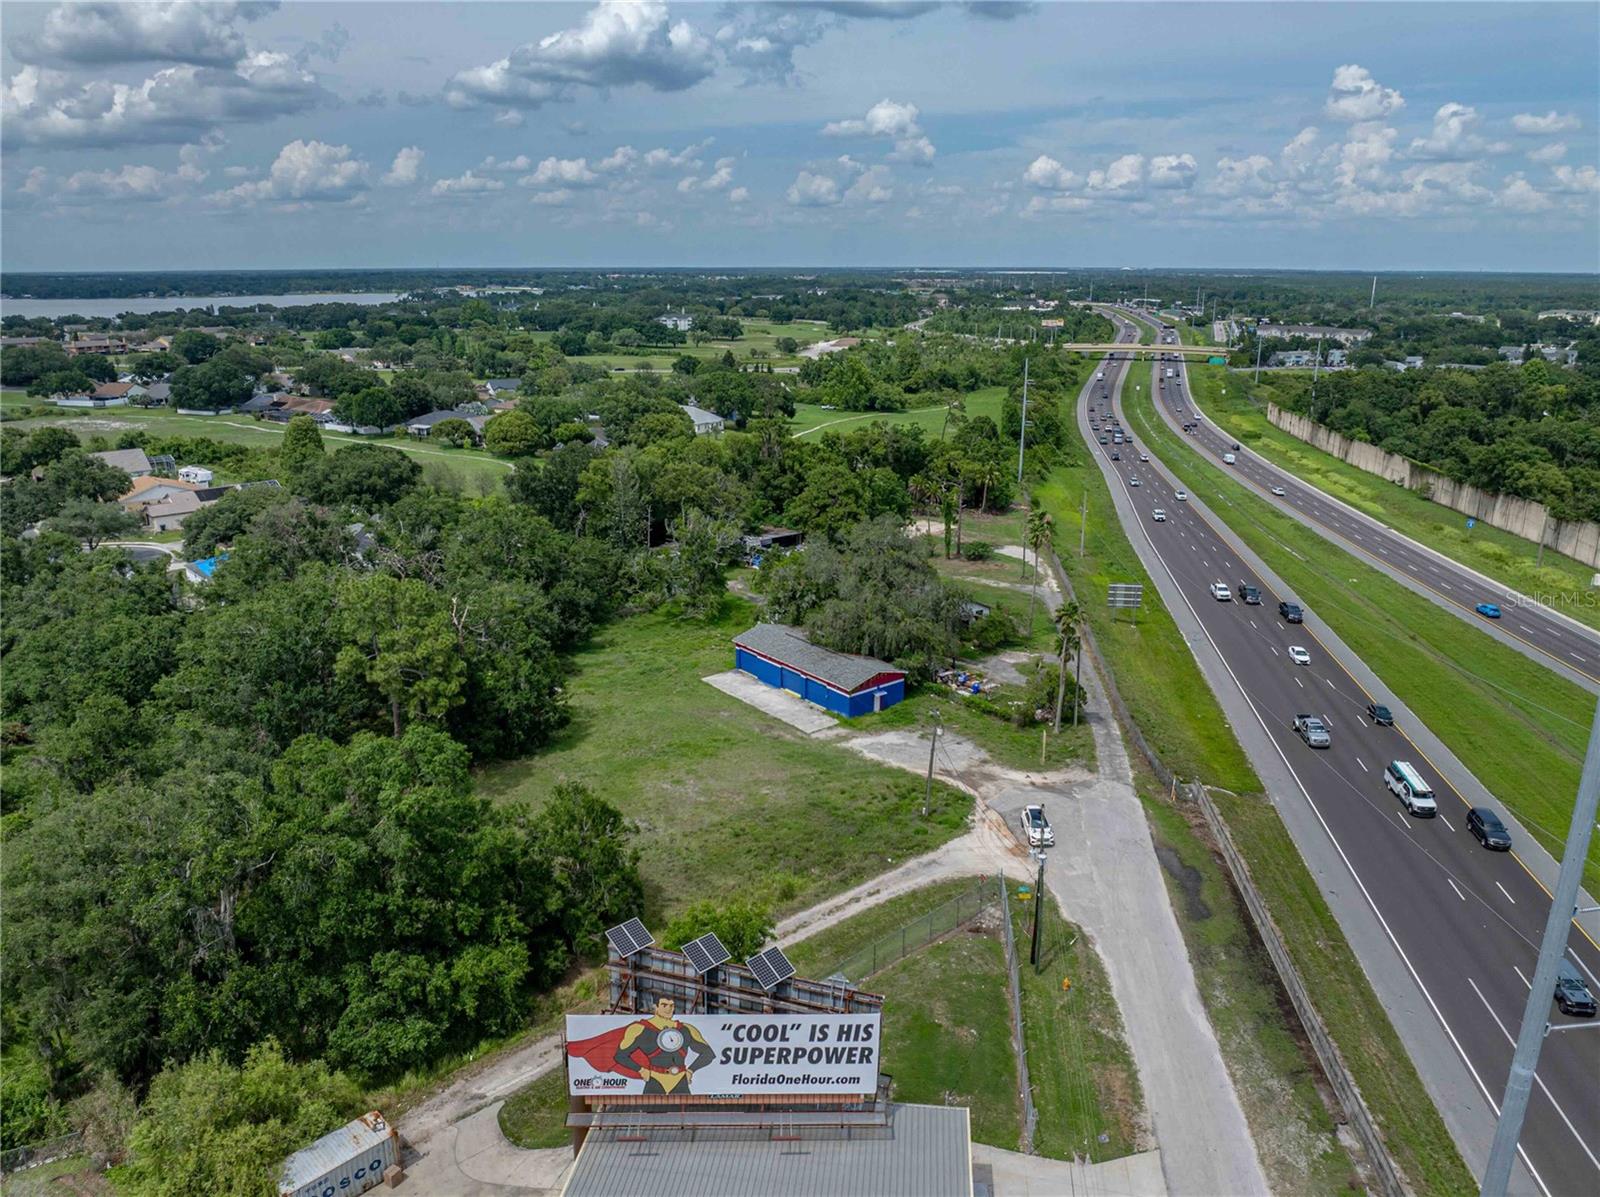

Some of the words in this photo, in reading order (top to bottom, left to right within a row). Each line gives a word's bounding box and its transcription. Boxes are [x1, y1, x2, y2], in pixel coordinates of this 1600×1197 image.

[809, 1023, 830, 1042] IS
[836, 1023, 875, 1042] HIS
[719, 1045, 874, 1065] SUPERPOWER
[573, 1078, 592, 1086] ONE
[603, 1078, 628, 1086] HOUR
[731, 1073, 861, 1085] FloridaOneHour.com
[311, 1159, 382, 1197] OSCO
